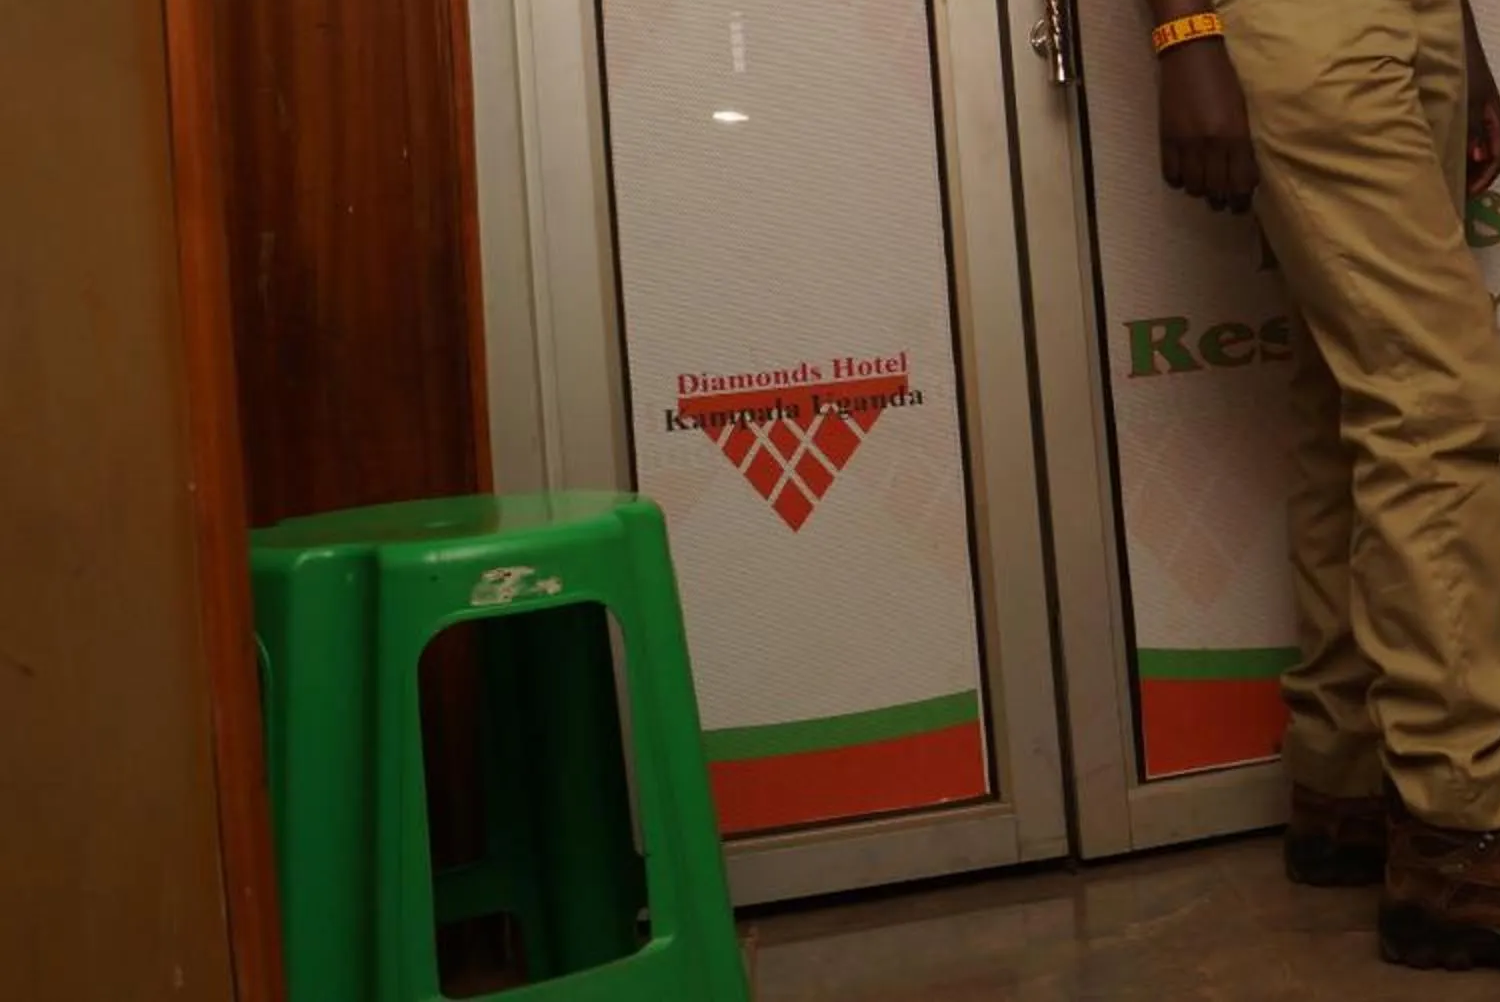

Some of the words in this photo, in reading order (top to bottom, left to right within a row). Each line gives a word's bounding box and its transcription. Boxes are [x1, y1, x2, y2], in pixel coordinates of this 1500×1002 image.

[677, 361, 822, 395] Diamonds
[832, 351, 909, 380] Hotel
[665, 397, 800, 431] Kampala
[811, 384, 924, 420] Uganda
